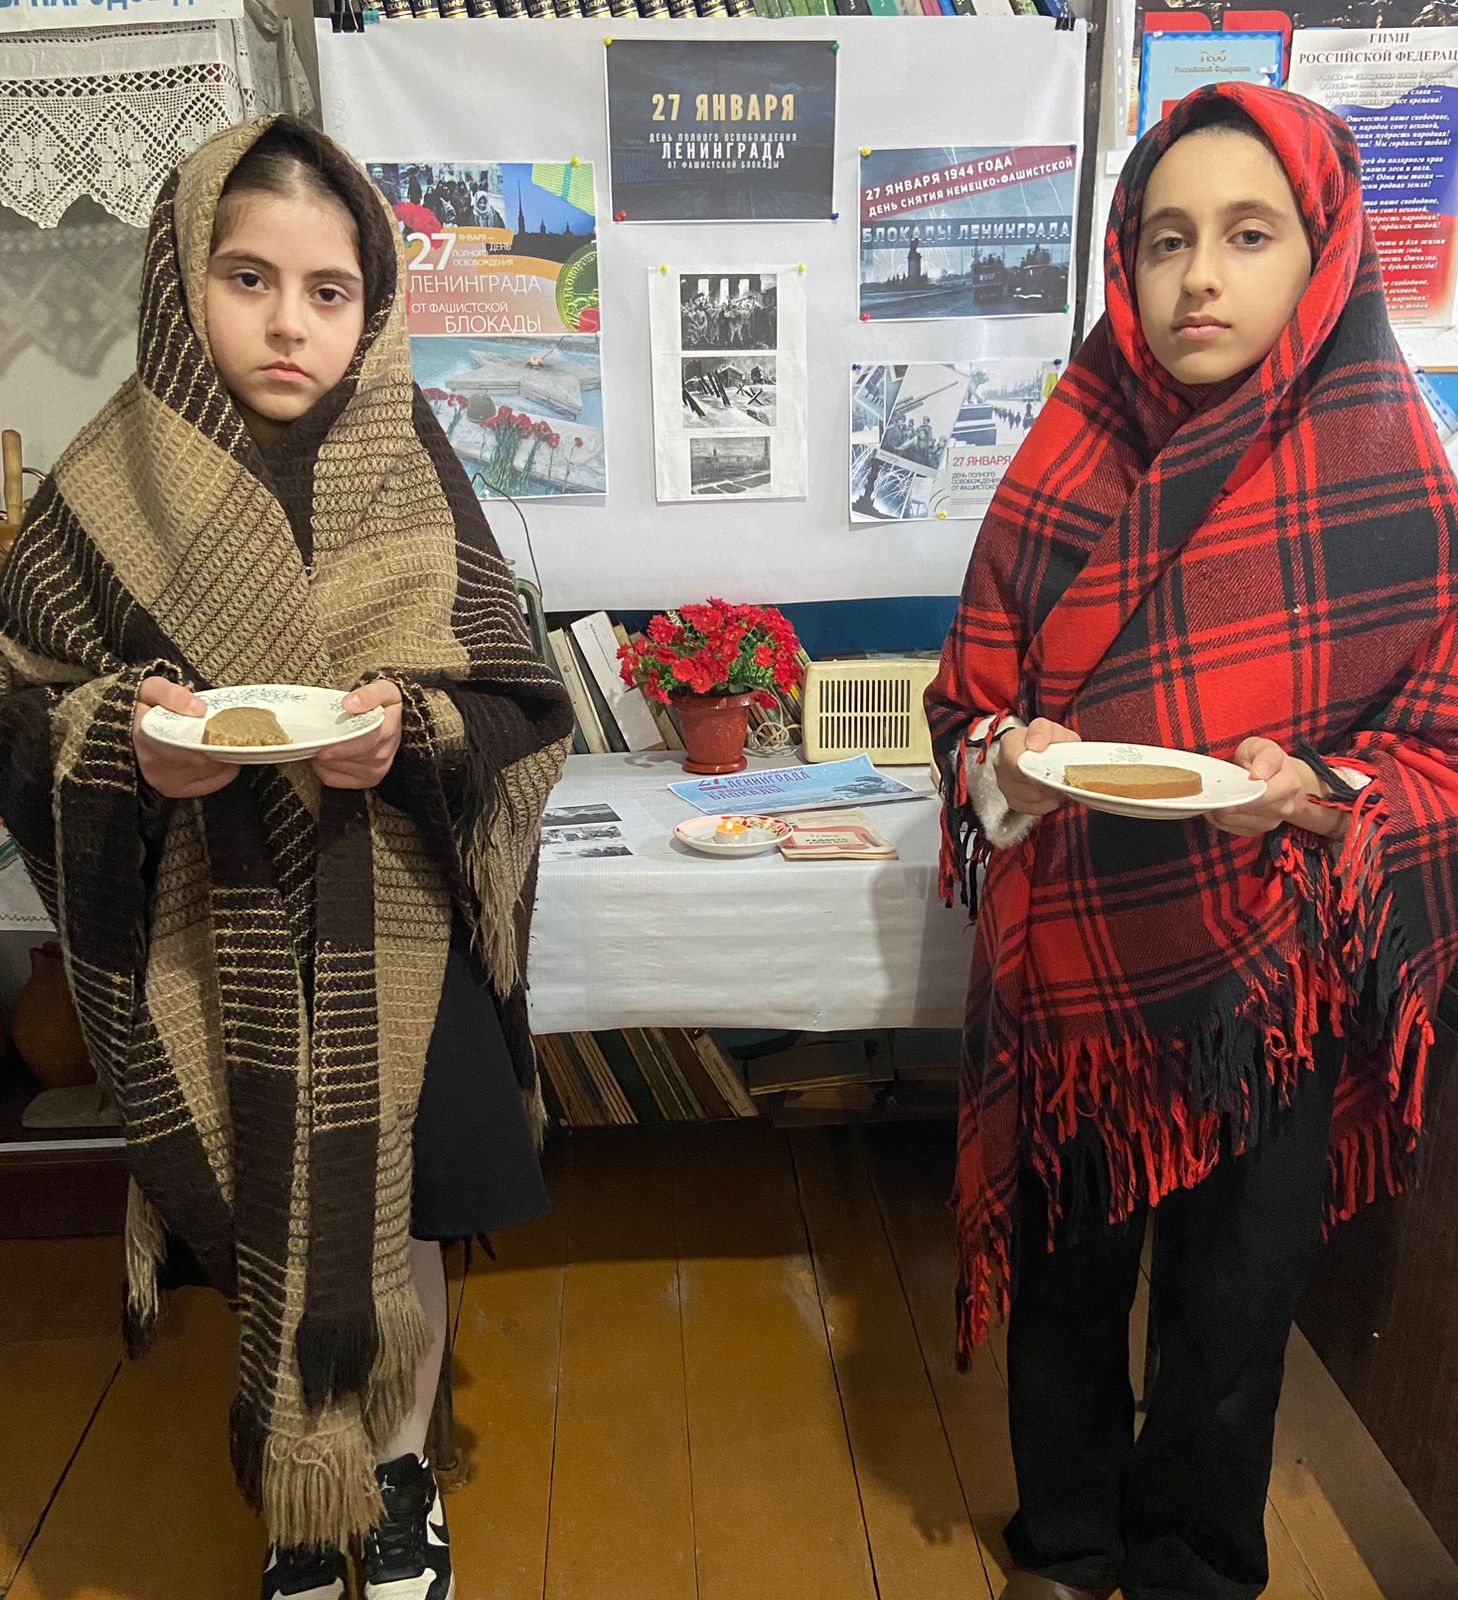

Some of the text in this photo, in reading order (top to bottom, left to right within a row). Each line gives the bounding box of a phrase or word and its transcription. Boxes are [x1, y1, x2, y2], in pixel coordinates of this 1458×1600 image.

[1369, 33, 1410, 44] ГИМН
[1299, 50, 1392, 64] РОССИЙСКОЙ
[651, 94, 796, 121] 27 ЯНВАРЯ
[649, 132, 797, 143] ДЕНЬ ПОЛНОГО ОСВОБОЖДЕНИЯ
[661, 142, 785, 161] ЛЕНИНГРАДА
[667, 160, 779, 170] ОТ ФАШИСТСКОЙ БЛОКАДЫ
[865, 155, 1013, 201] 27 ЯНВАРЯ 1944 ГОДА
[868, 157, 1073, 218] ДЕНЬ СНЯТИЯ НЕМЕЦКО-ФАШИСТСКОЙ
[862, 222, 1071, 243] БЛОКАДЫ ЛЕНИНГРАДА
[406, 232, 456, 271] 27
[490, 243, 512, 251] ДЕНЬ
[453, 258, 514, 267] ОСВОБОЖДЕНИЯ
[409, 274, 542, 295] ЛЕНИНГРАДА
[411, 301, 509, 314] ОТ ФАШИСТСКОЙ
[445, 315, 542, 334] БЛОКАДЫ
[952, 455, 1011, 467] 27 ЯНВАРЯ
[727, 770, 810, 788] ЛЕНИНГРАДА
